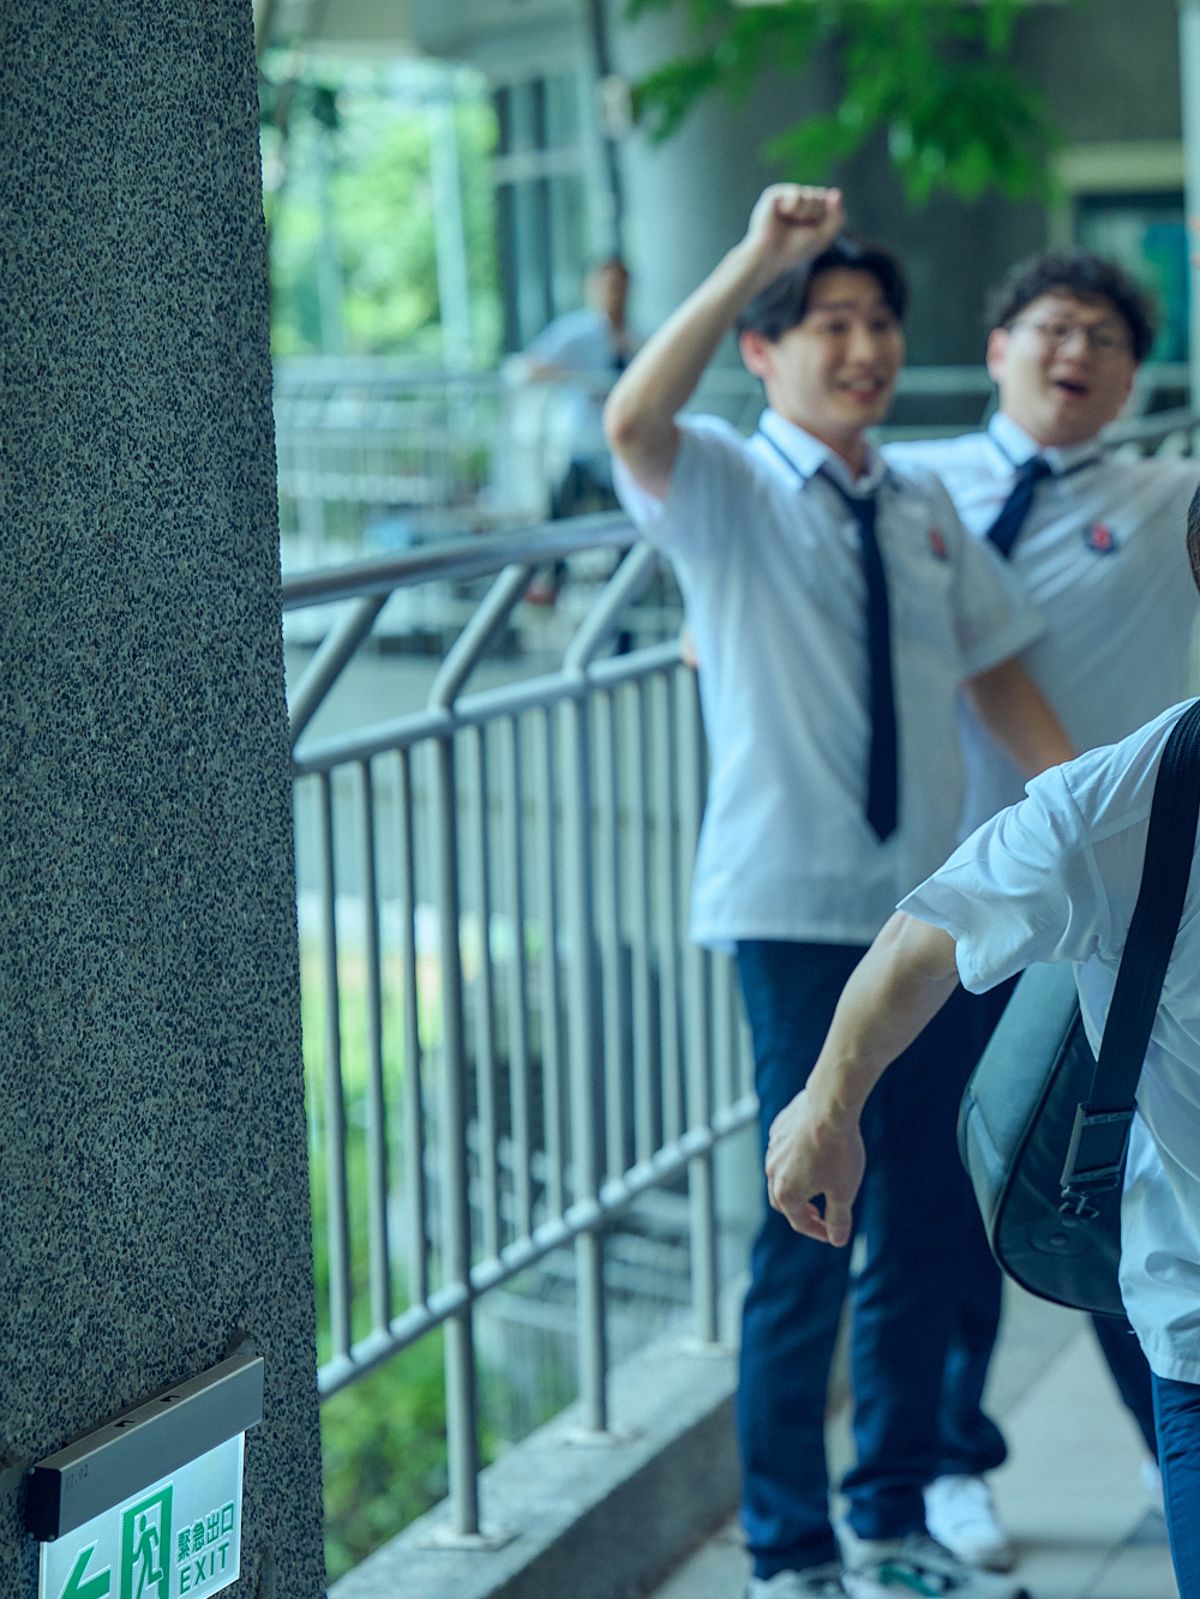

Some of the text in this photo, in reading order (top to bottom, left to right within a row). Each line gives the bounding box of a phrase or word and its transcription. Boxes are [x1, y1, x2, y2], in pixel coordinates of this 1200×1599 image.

[178, 1502, 234, 1562] 緊急出口
[180, 1541, 230, 1595] EXIT
